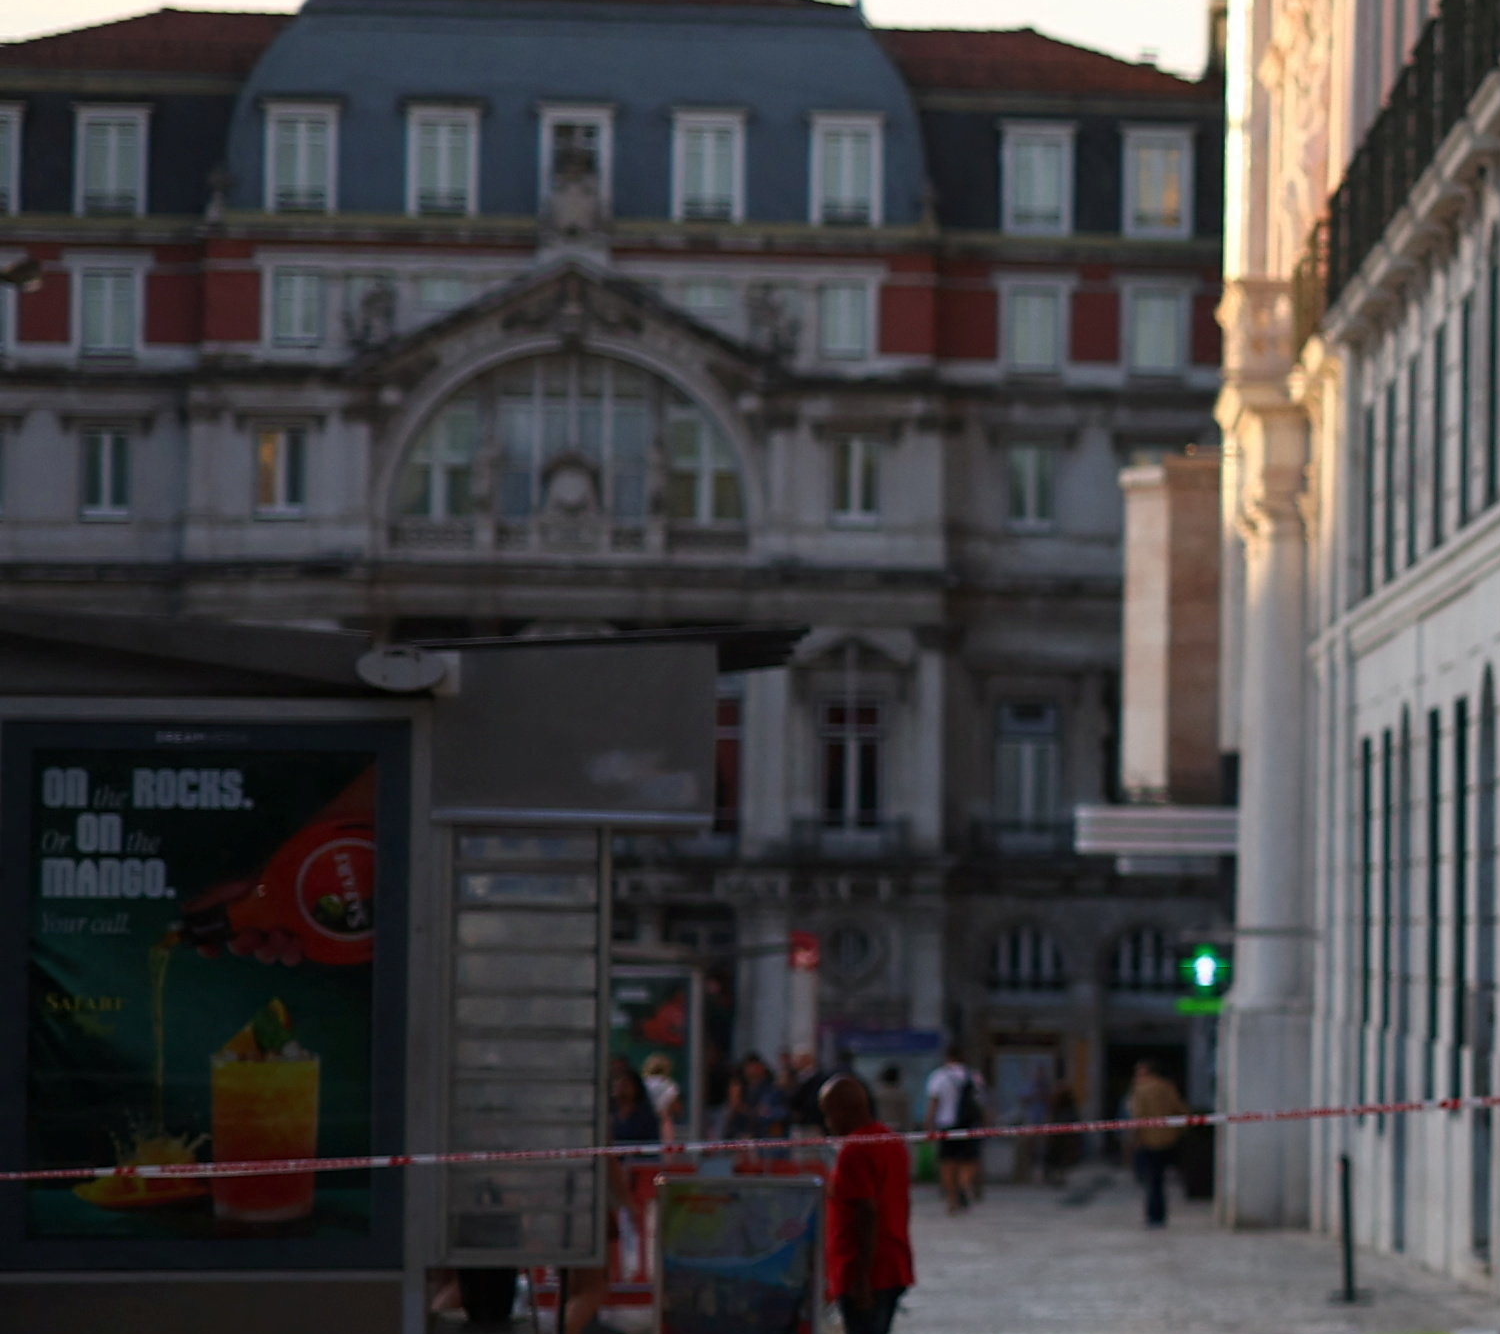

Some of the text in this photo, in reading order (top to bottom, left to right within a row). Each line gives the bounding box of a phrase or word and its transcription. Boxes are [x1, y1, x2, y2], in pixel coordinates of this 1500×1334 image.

[42, 767, 89, 809] ON
[133, 767, 255, 811] ROCKS.
[76, 812, 123, 854] ON
[41, 857, 177, 899] MANGO.
